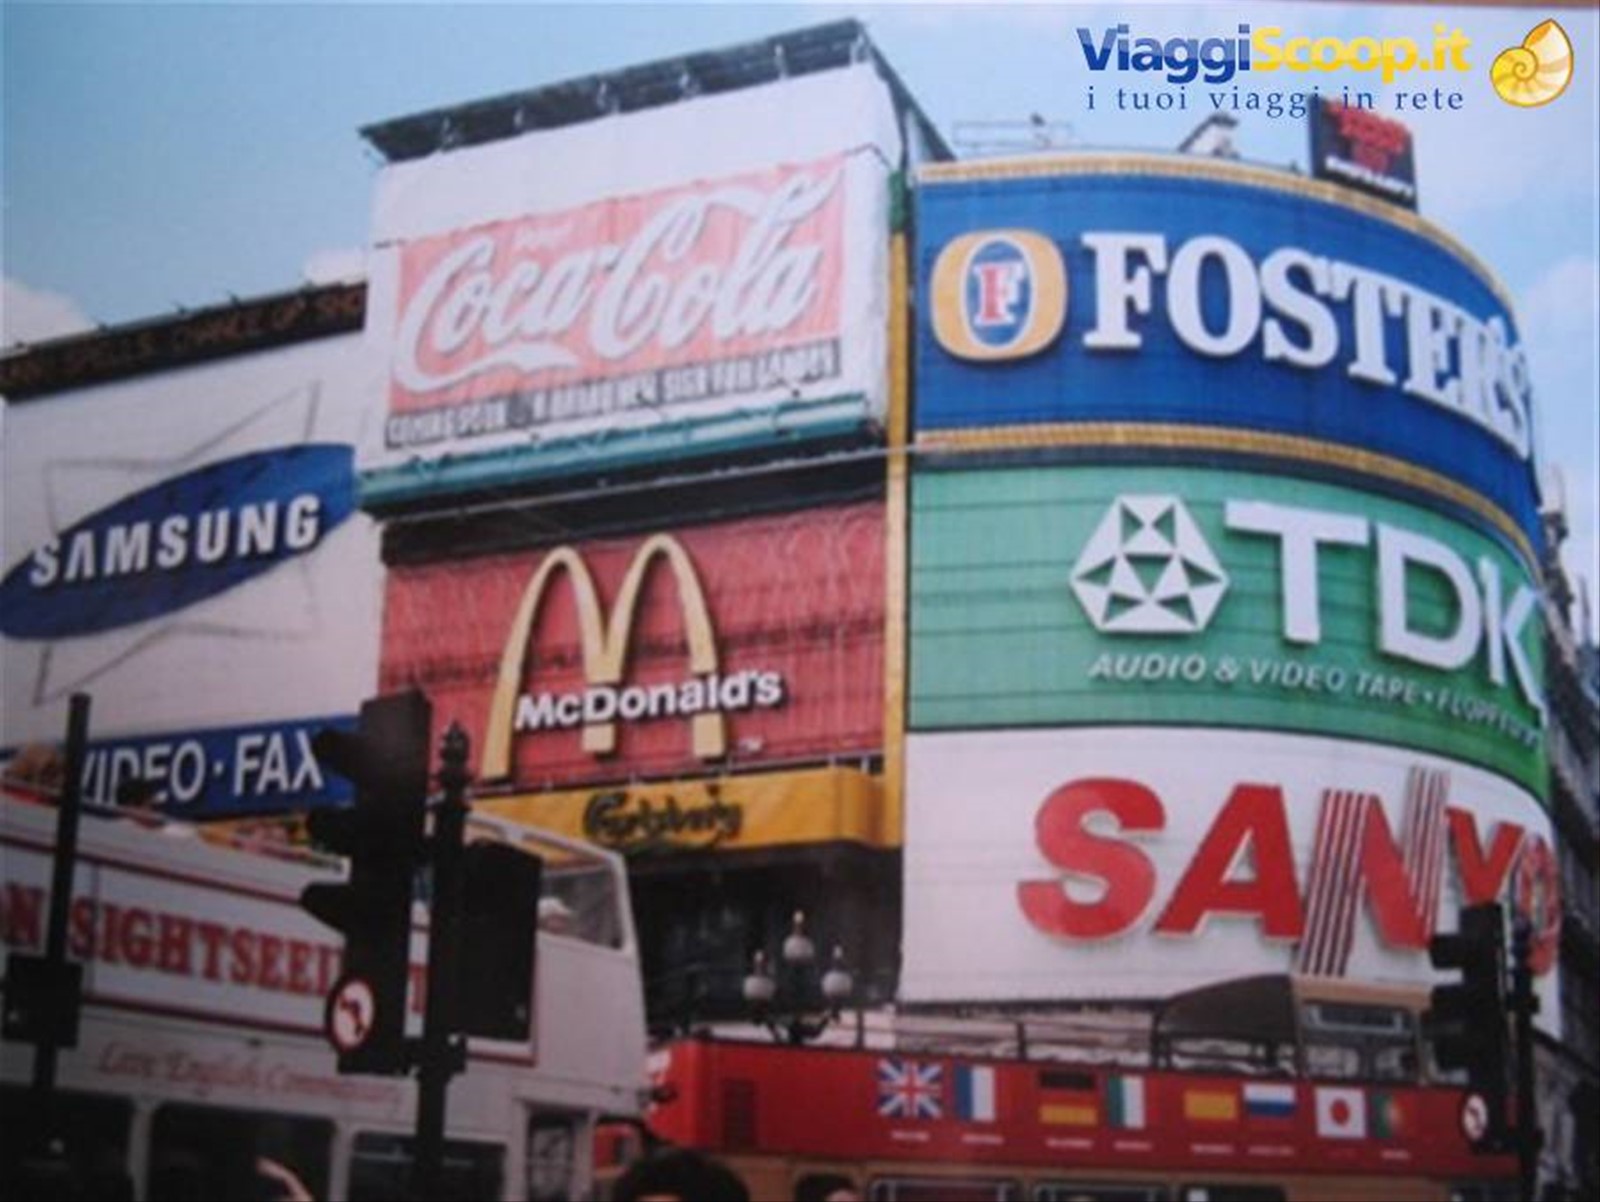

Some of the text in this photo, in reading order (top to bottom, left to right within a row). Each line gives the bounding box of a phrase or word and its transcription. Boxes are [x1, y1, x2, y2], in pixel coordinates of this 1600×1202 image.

[30, 494, 321, 586] SAMSUNG
[1223, 499, 1547, 714] TDK
[515, 670, 782, 730] McDonald's
[1088, 653, 1207, 684] AUDIO
[1250, 658, 1346, 692] VIDEO
[1354, 671, 1418, 706] TAPE
[233, 729, 324, 797] FAX
[1016, 764, 1562, 977] SANYO
[71, 895, 345, 997] SIGHTSEEI
